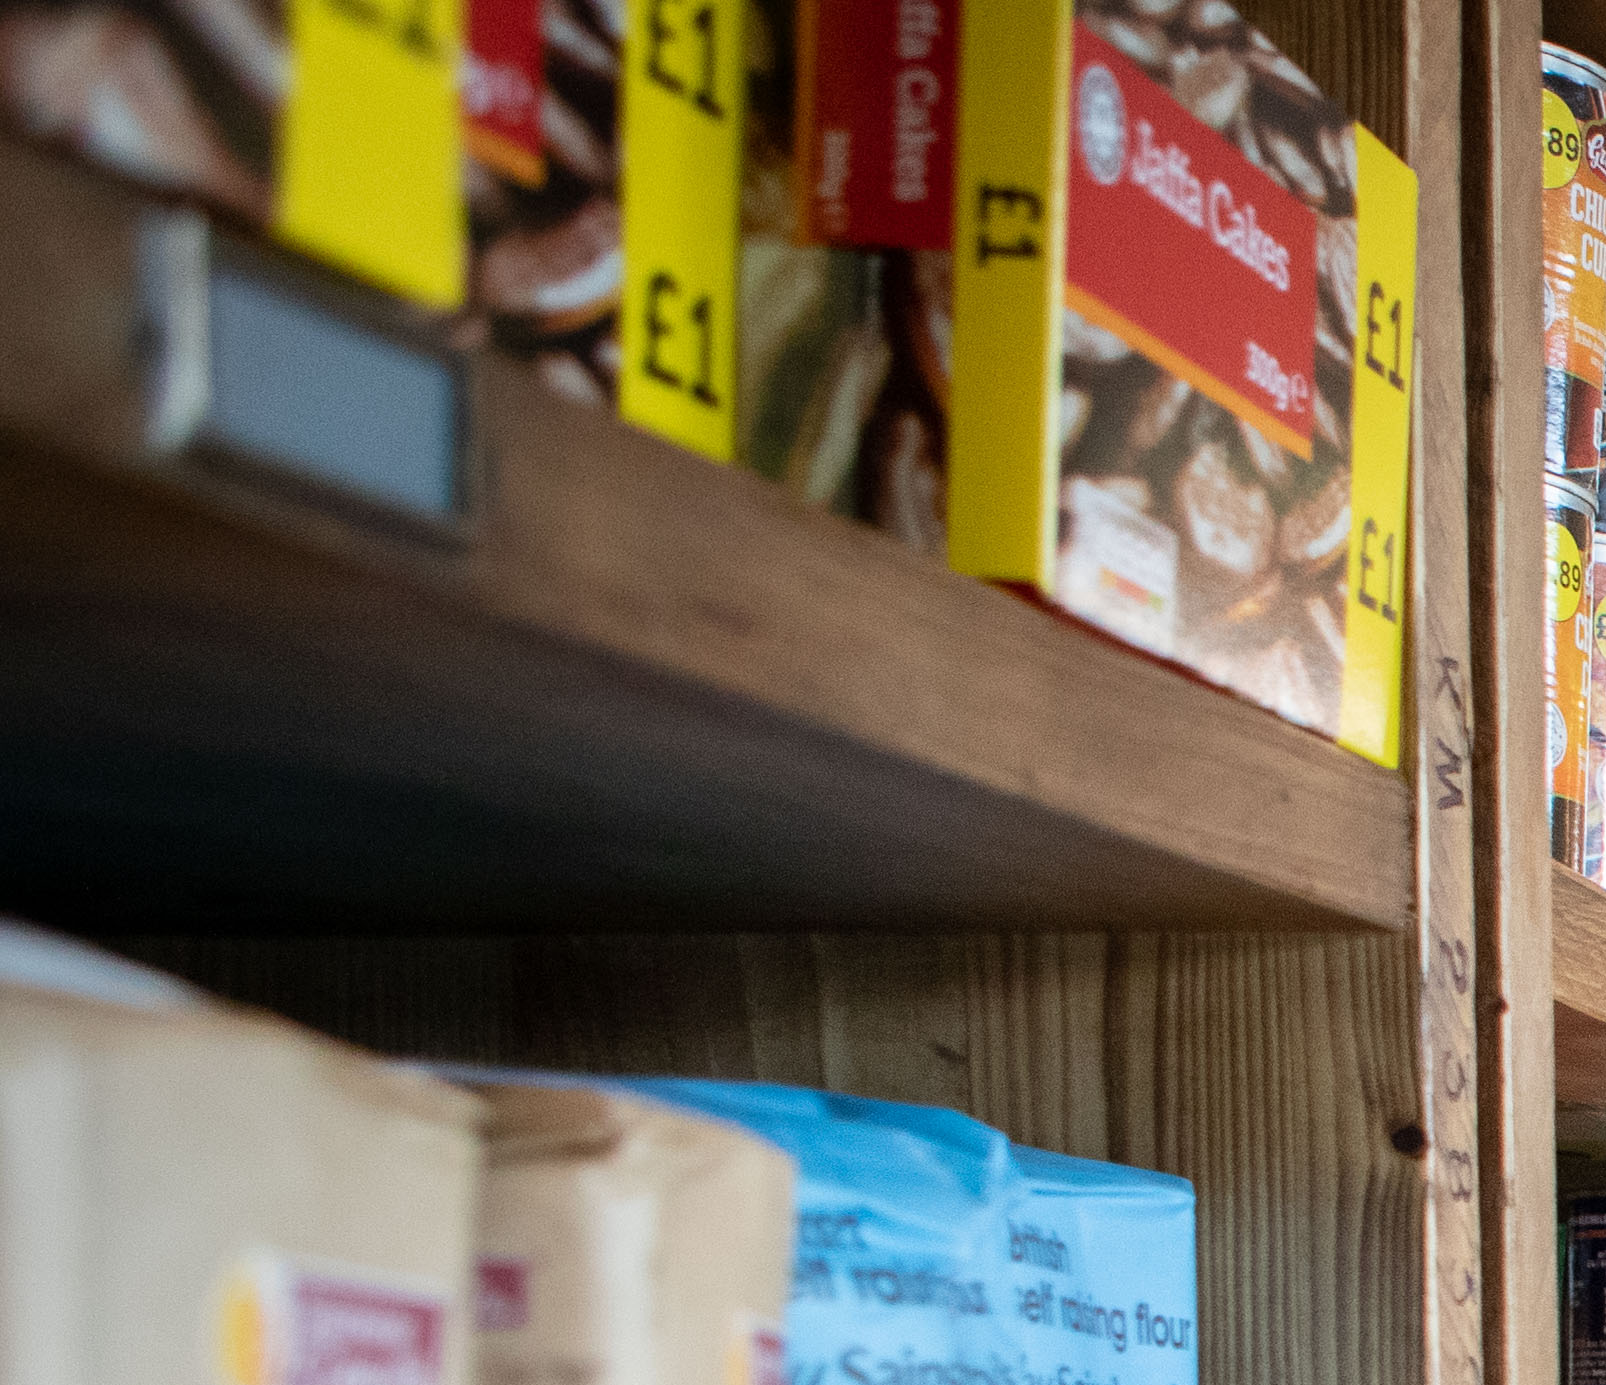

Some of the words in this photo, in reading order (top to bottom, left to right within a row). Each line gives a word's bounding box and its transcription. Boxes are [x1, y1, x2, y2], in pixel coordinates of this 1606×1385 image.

[975, 181, 1042, 268] £1
[1131, 116, 1204, 230] Jaffa
[1208, 178, 1290, 292] Cakes
[645, 268, 720, 410] £1
[1364, 280, 1406, 394] £1
[1356, 517, 1398, 624] £1
[1135, 1303, 1192, 1351] flour
